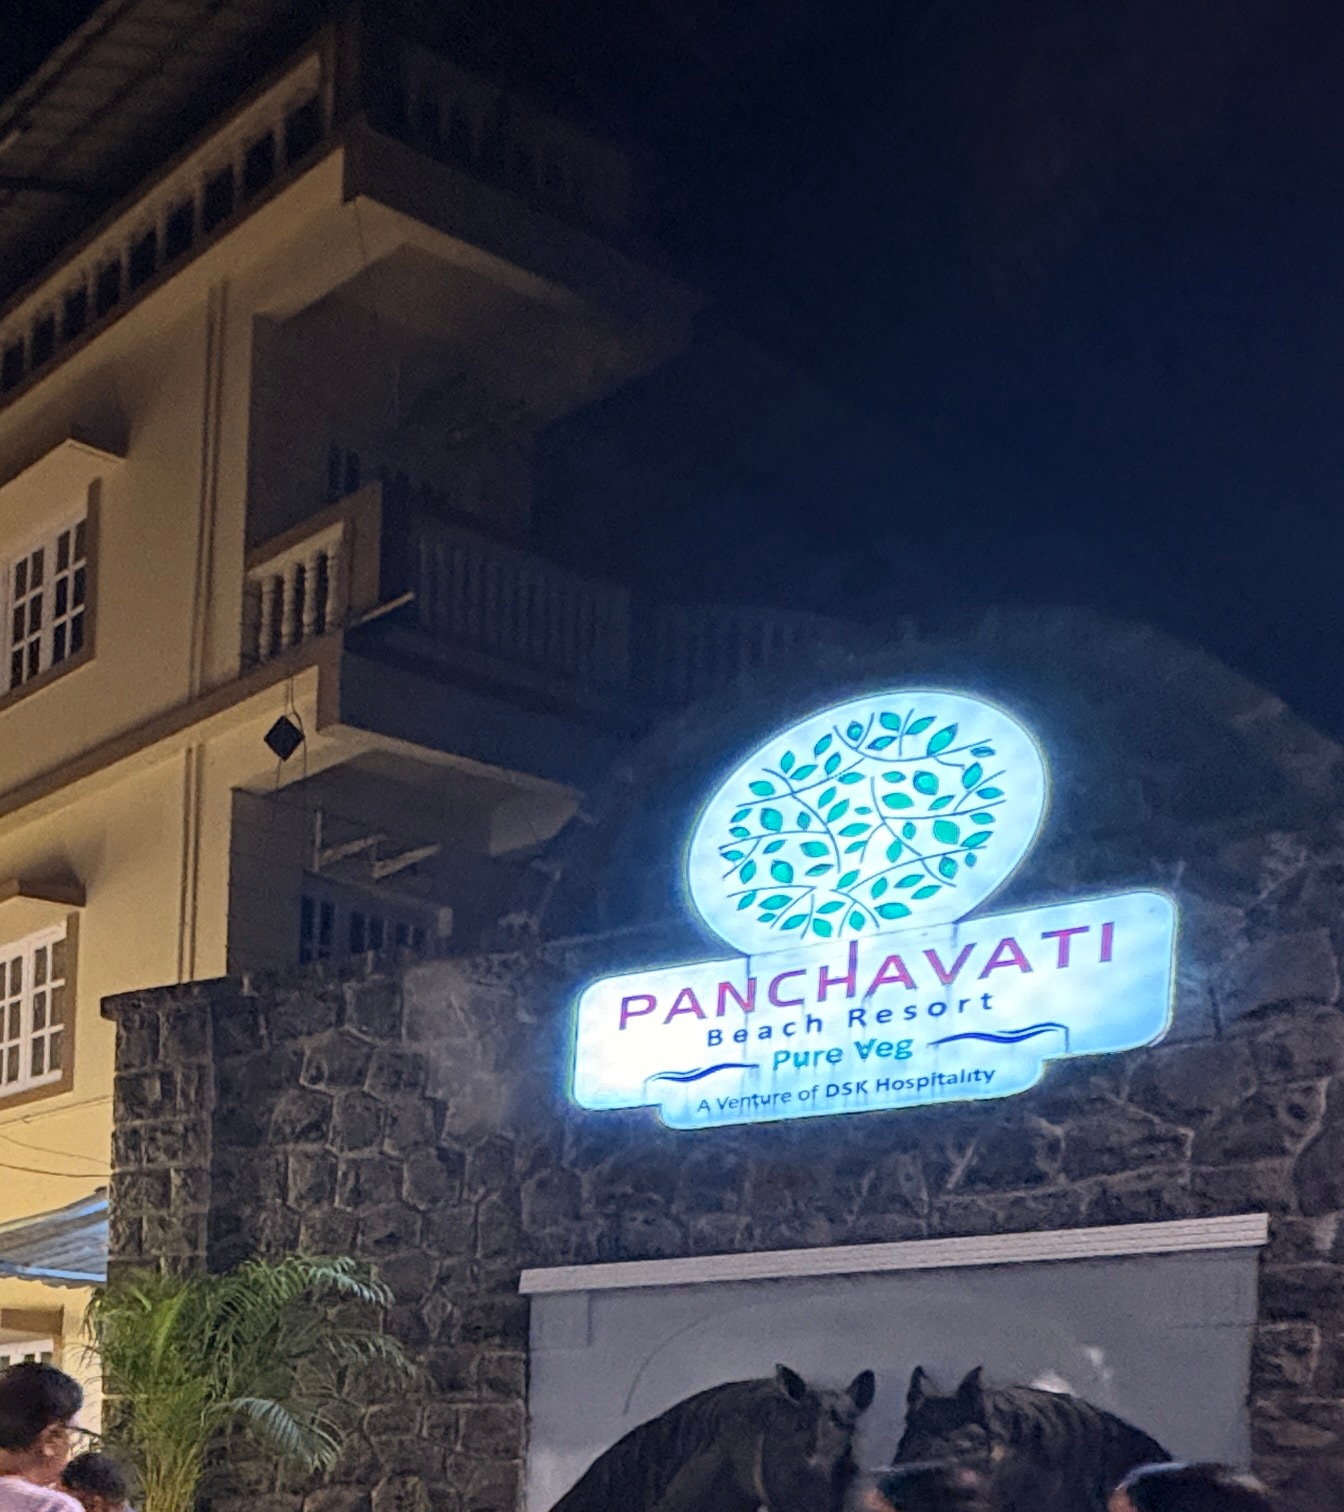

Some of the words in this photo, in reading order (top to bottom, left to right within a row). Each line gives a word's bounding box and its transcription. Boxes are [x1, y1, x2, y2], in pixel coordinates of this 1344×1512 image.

[618, 920, 1115, 1031] PANCHAVATI
[707, 1013, 824, 1047] Beach
[847, 992, 994, 1028] Resort
[772, 1046, 844, 1071] Pure
[854, 1037, 914, 1061] Veg
[697, 1098, 712, 1113] A
[716, 1089, 793, 1110] Venture
[798, 1084, 820, 1101] of
[825, 1079, 869, 1099] DSK
[875, 1068, 997, 1094] Hospitality
